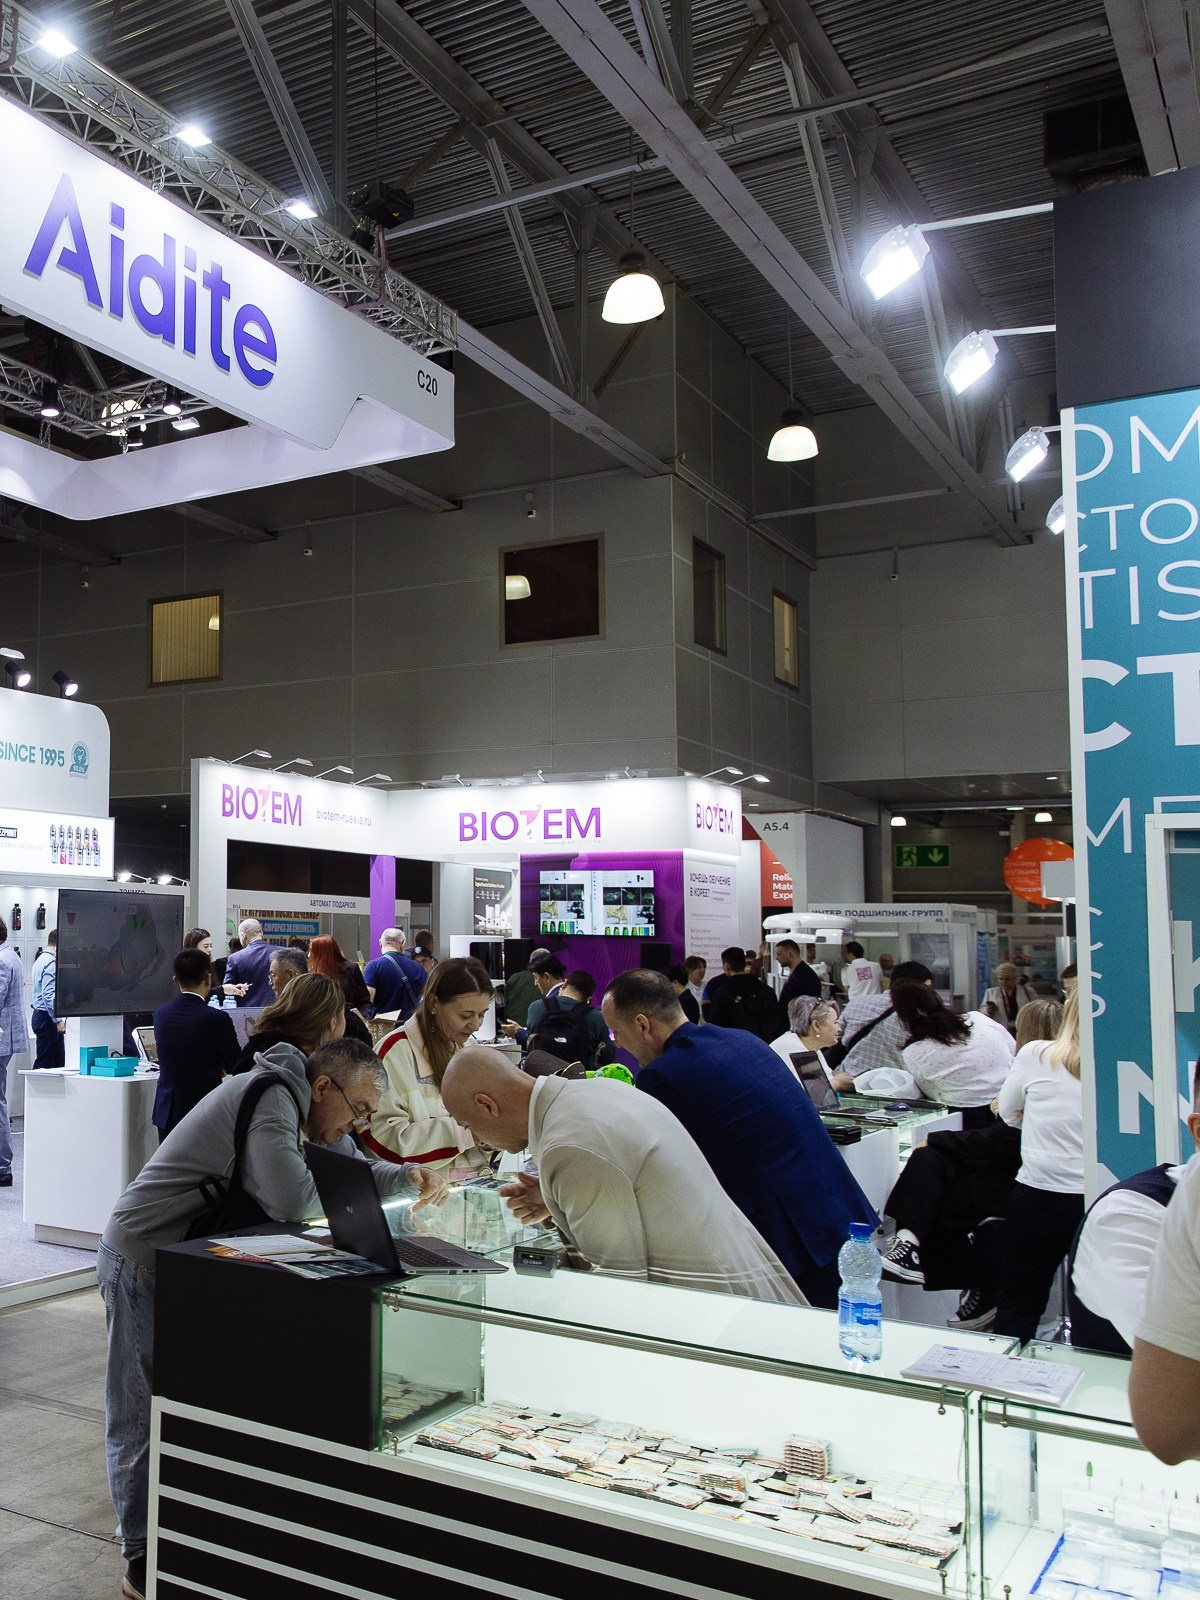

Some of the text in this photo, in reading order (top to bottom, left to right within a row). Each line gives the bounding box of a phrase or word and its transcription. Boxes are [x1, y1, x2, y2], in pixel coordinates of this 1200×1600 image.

[23, 172, 278, 390] Aidite
[417, 369, 438, 397] C20
[40, 747, 65, 768] 1995
[221, 784, 303, 827] BIOTEM
[316, 808, 372, 827] biotem-russia.ru
[459, 804, 601, 842] BIOTEM
[695, 803, 734, 835] BIOTEM
[763, 822, 789, 831] A5.4
[332, 901, 356, 909] ПОДАРКОВ
[845, 909, 943, 918] ПОДШИПНИК-ГРУПП
